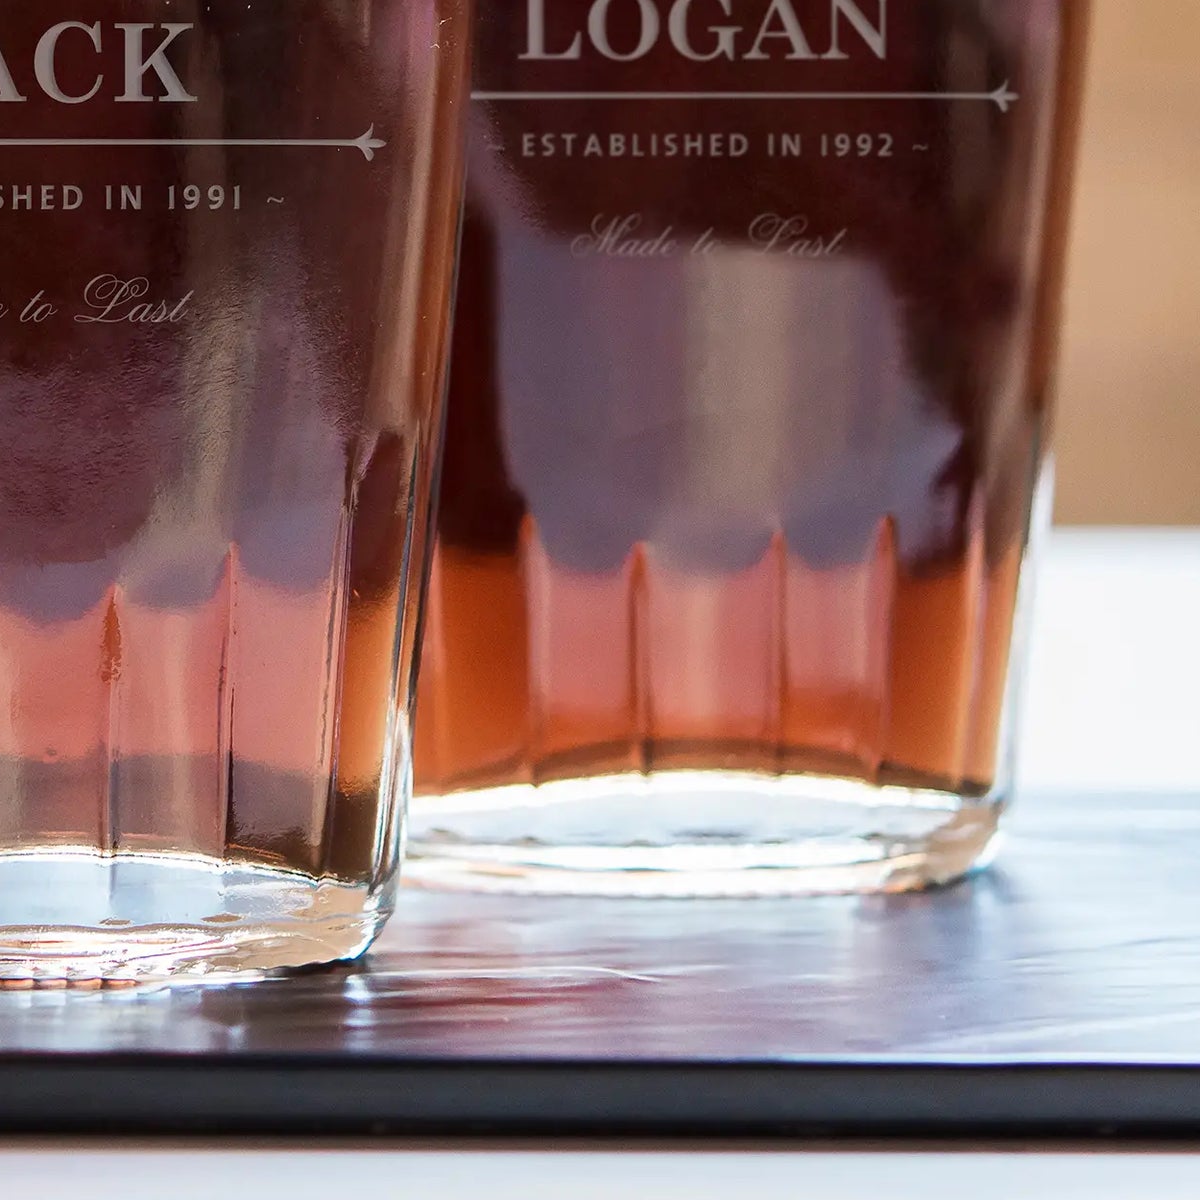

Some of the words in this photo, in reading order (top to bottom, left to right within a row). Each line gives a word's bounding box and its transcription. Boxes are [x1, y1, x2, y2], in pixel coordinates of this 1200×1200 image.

[522, 133, 749, 158] ESTABLISHED
[767, 133, 801, 158] IN
[820, 133, 895, 158] 1992
[105, 184, 142, 212] IN
[167, 184, 243, 212] 1991
[570, 211, 677, 259] Made
[745, 212, 848, 258] Last
[19, 287, 59, 325] to
[73, 273, 197, 325] Last
